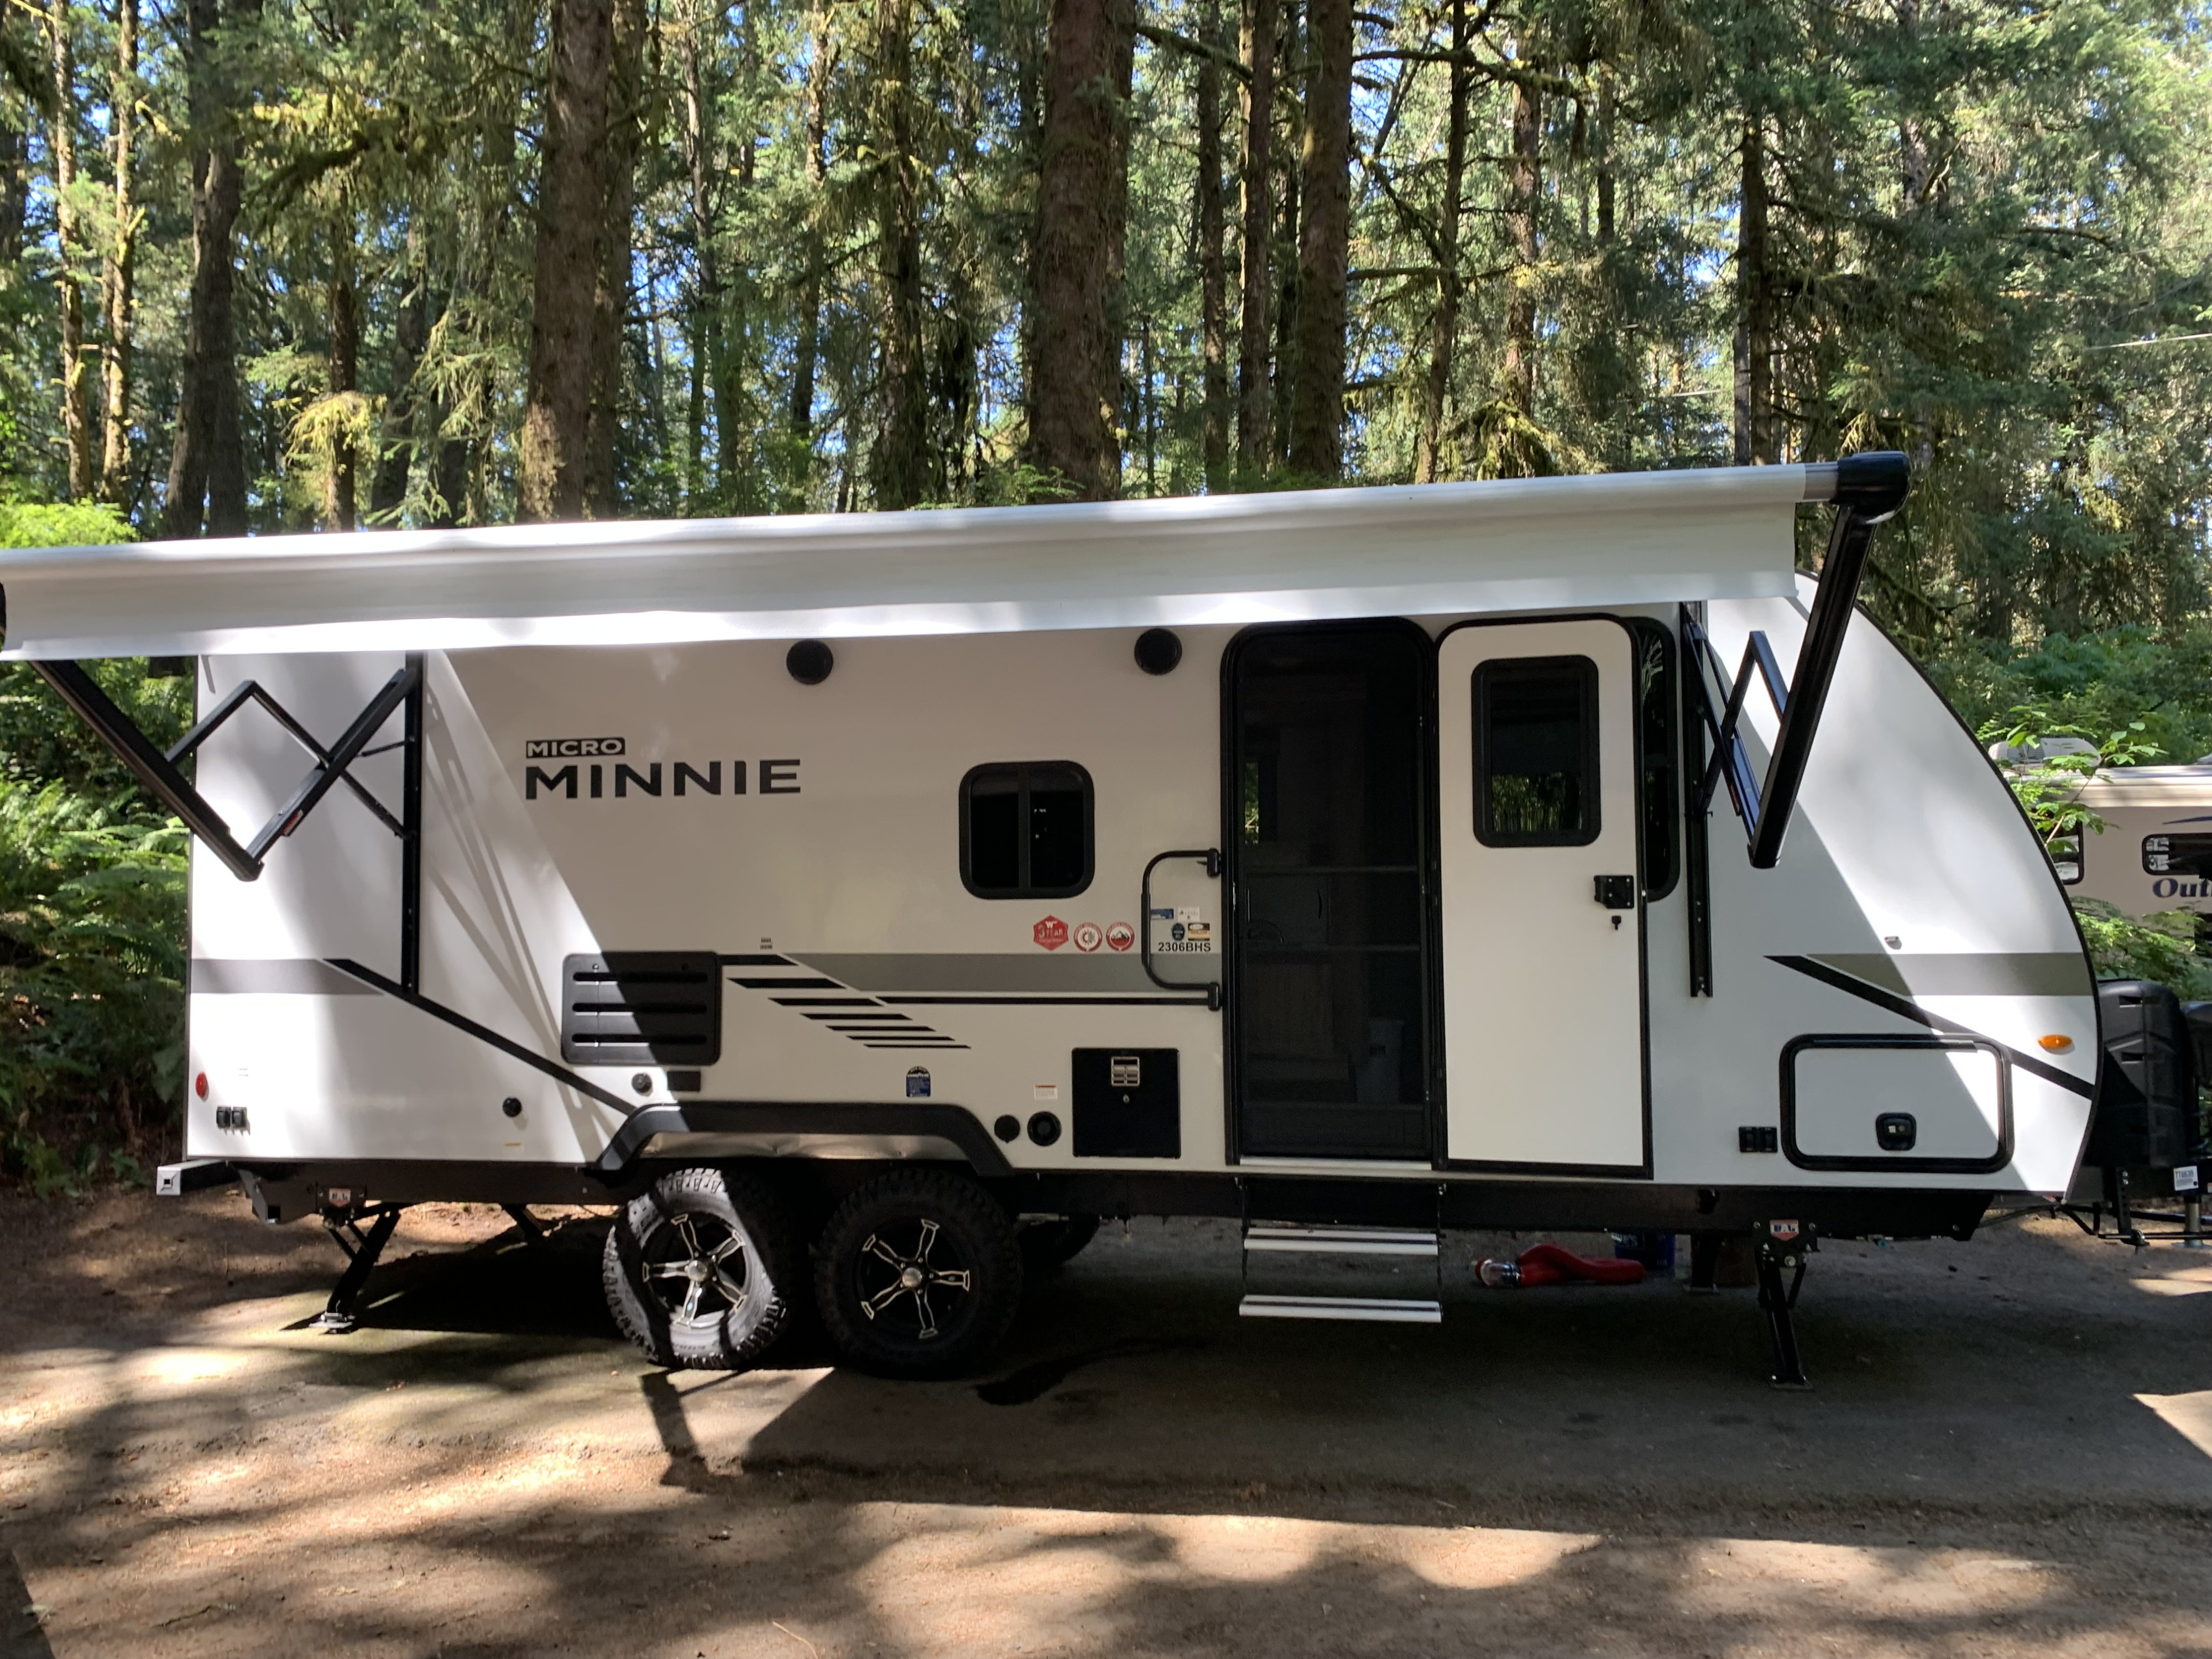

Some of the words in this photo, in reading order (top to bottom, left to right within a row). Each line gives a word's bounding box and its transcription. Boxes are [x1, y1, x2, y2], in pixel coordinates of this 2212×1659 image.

[527, 739, 623, 757] MICRO
[526, 759, 801, 800] MINNIE
[2152, 878, 2212, 898] Out
[1158, 942, 1211, 952] 2306BHS
